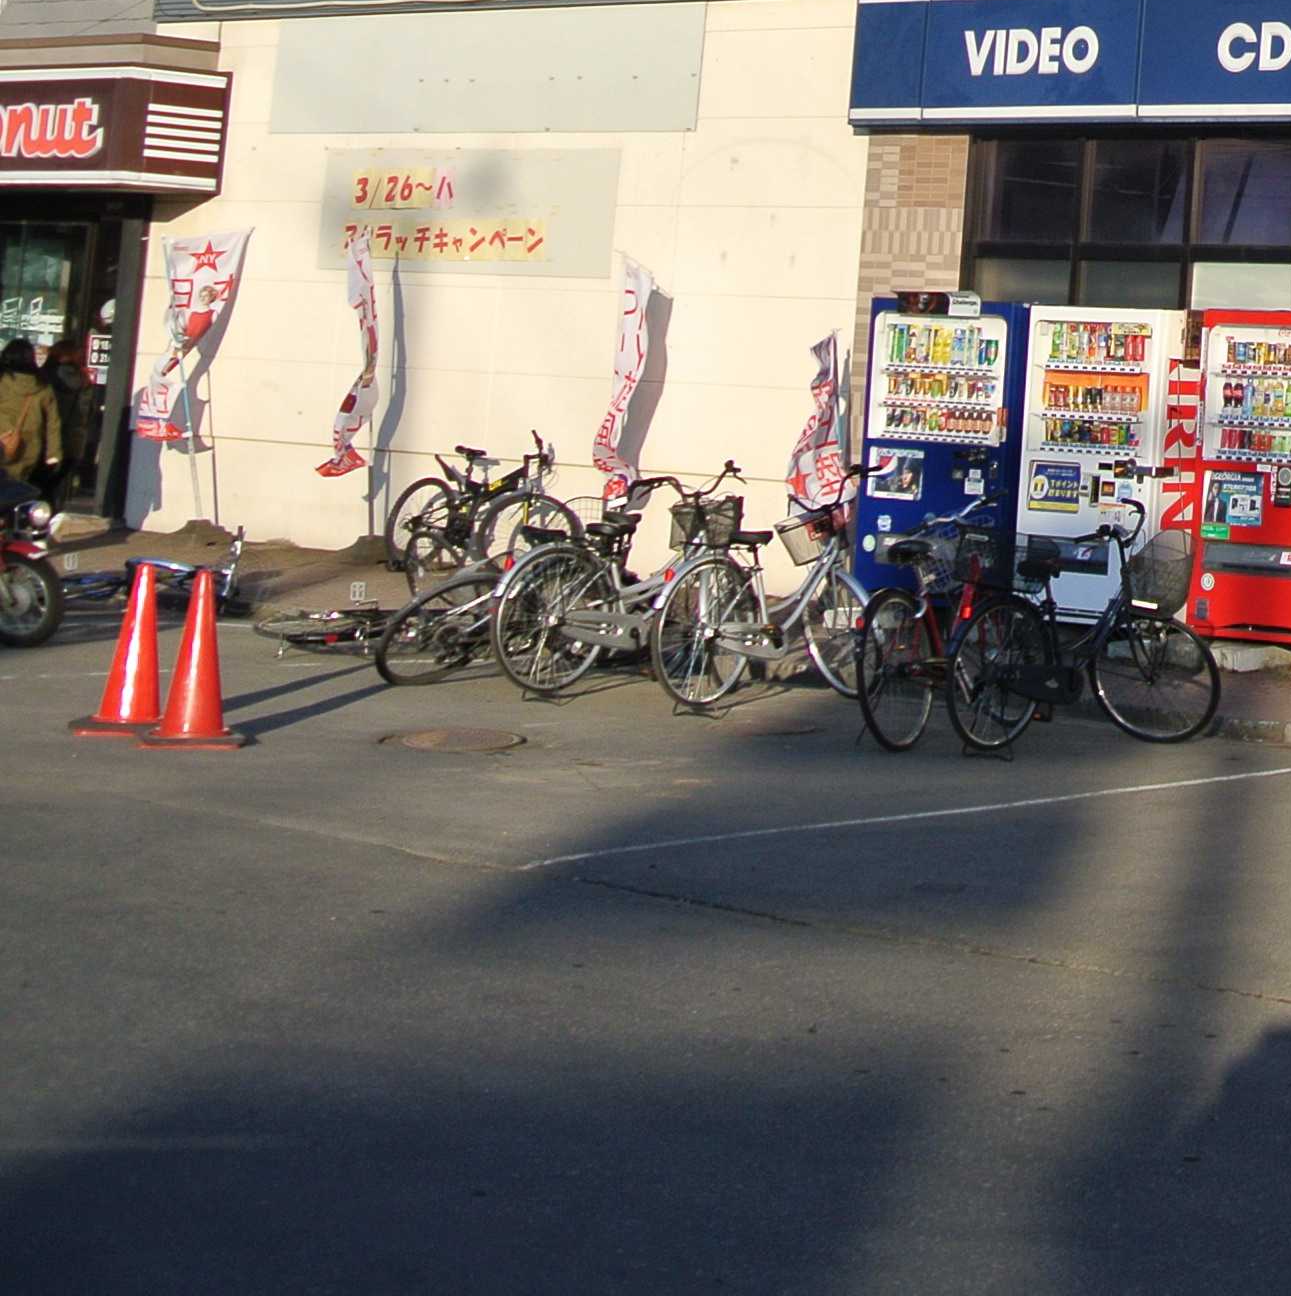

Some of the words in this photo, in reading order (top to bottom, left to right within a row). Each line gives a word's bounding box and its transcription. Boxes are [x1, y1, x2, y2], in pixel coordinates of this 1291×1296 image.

[964, 25, 1099, 76] VIDEO
[0, 97, 104, 158] nut
[344, 224, 544, 253] スラッチキャンペーン
[1159, 358, 1200, 531] IRIN
